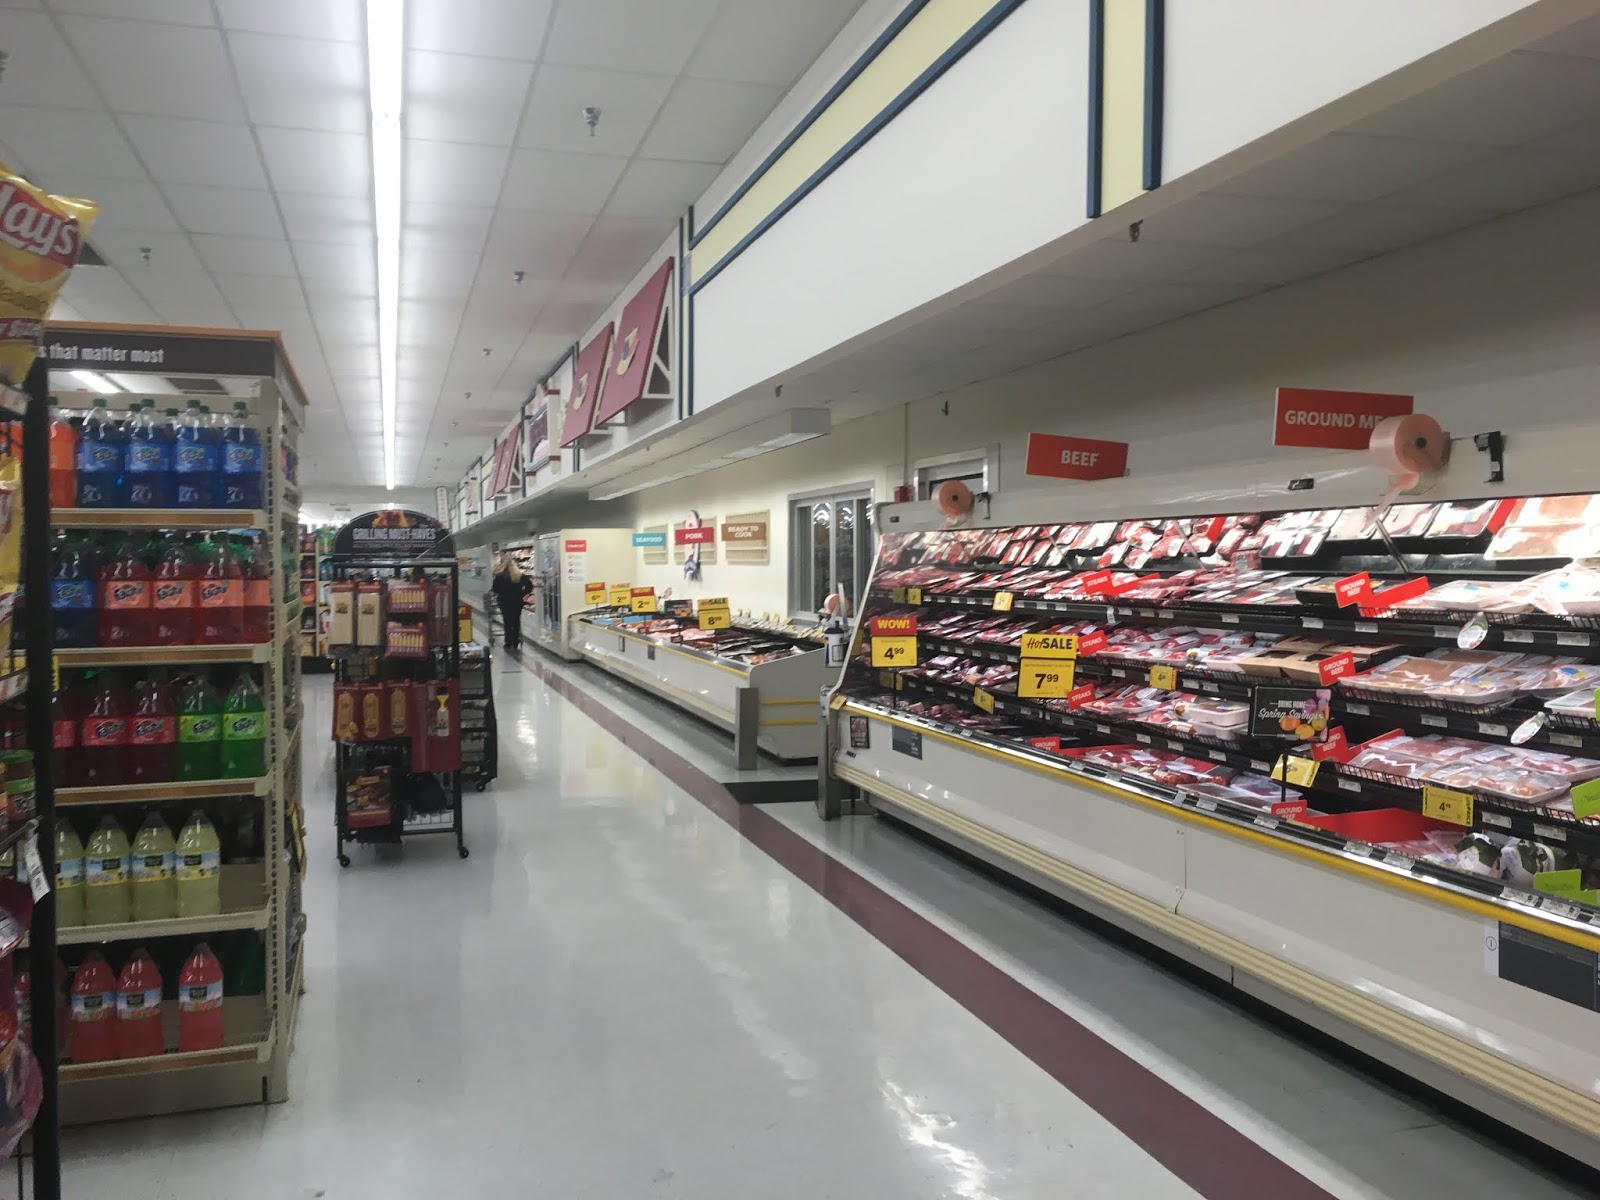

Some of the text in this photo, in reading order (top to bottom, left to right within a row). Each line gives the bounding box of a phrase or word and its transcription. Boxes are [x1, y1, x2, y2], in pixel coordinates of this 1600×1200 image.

[49, 343, 78, 359] that
[81, 347, 127, 362] matter
[130, 348, 164, 363] most
[1285, 410, 1383, 429] GROUND ME
[1061, 449, 1099, 467] BEEF
[353, 527, 437, 541] GRILLING MUST-HAVES
[685, 532, 704, 540] PORK
[1086, 576, 1109, 588] STEAKS
[1340, 578, 1366, 592] GROUND
[1346, 586, 1361, 597] BEEF
[877, 619, 910, 629] WOW!
[1042, 638, 1073, 650] SALE
[1081, 637, 1103, 649] STEAKS
[1323, 657, 1349, 671] GROUND
[1330, 665, 1344, 676] BEEF
[1071, 690, 1092, 702] STEAKS
[1258, 707, 1319, 725] Spring Savings
[1276, 806, 1303, 815] GROUND
